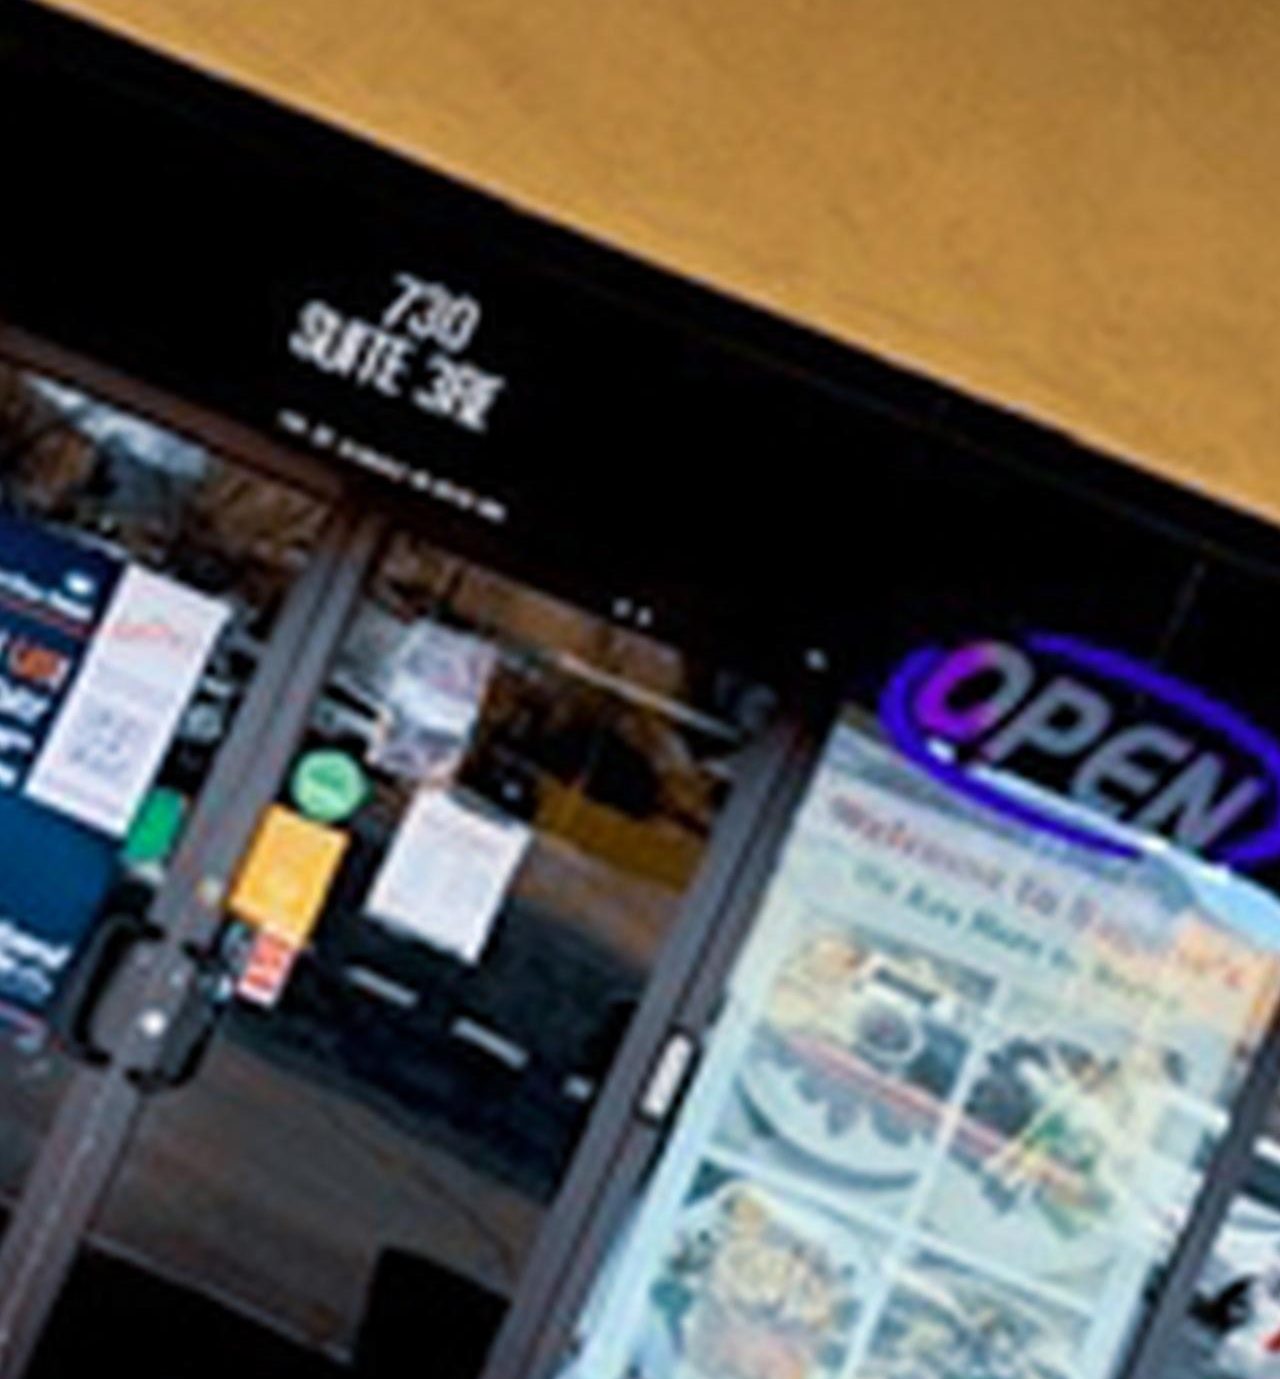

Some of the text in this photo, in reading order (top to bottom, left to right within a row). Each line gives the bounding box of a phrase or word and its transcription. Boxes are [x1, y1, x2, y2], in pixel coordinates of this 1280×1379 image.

[287, 298, 417, 398] SUITE
[381, 271, 482, 354] 730
[915, 638, 1268, 850] OPEN
